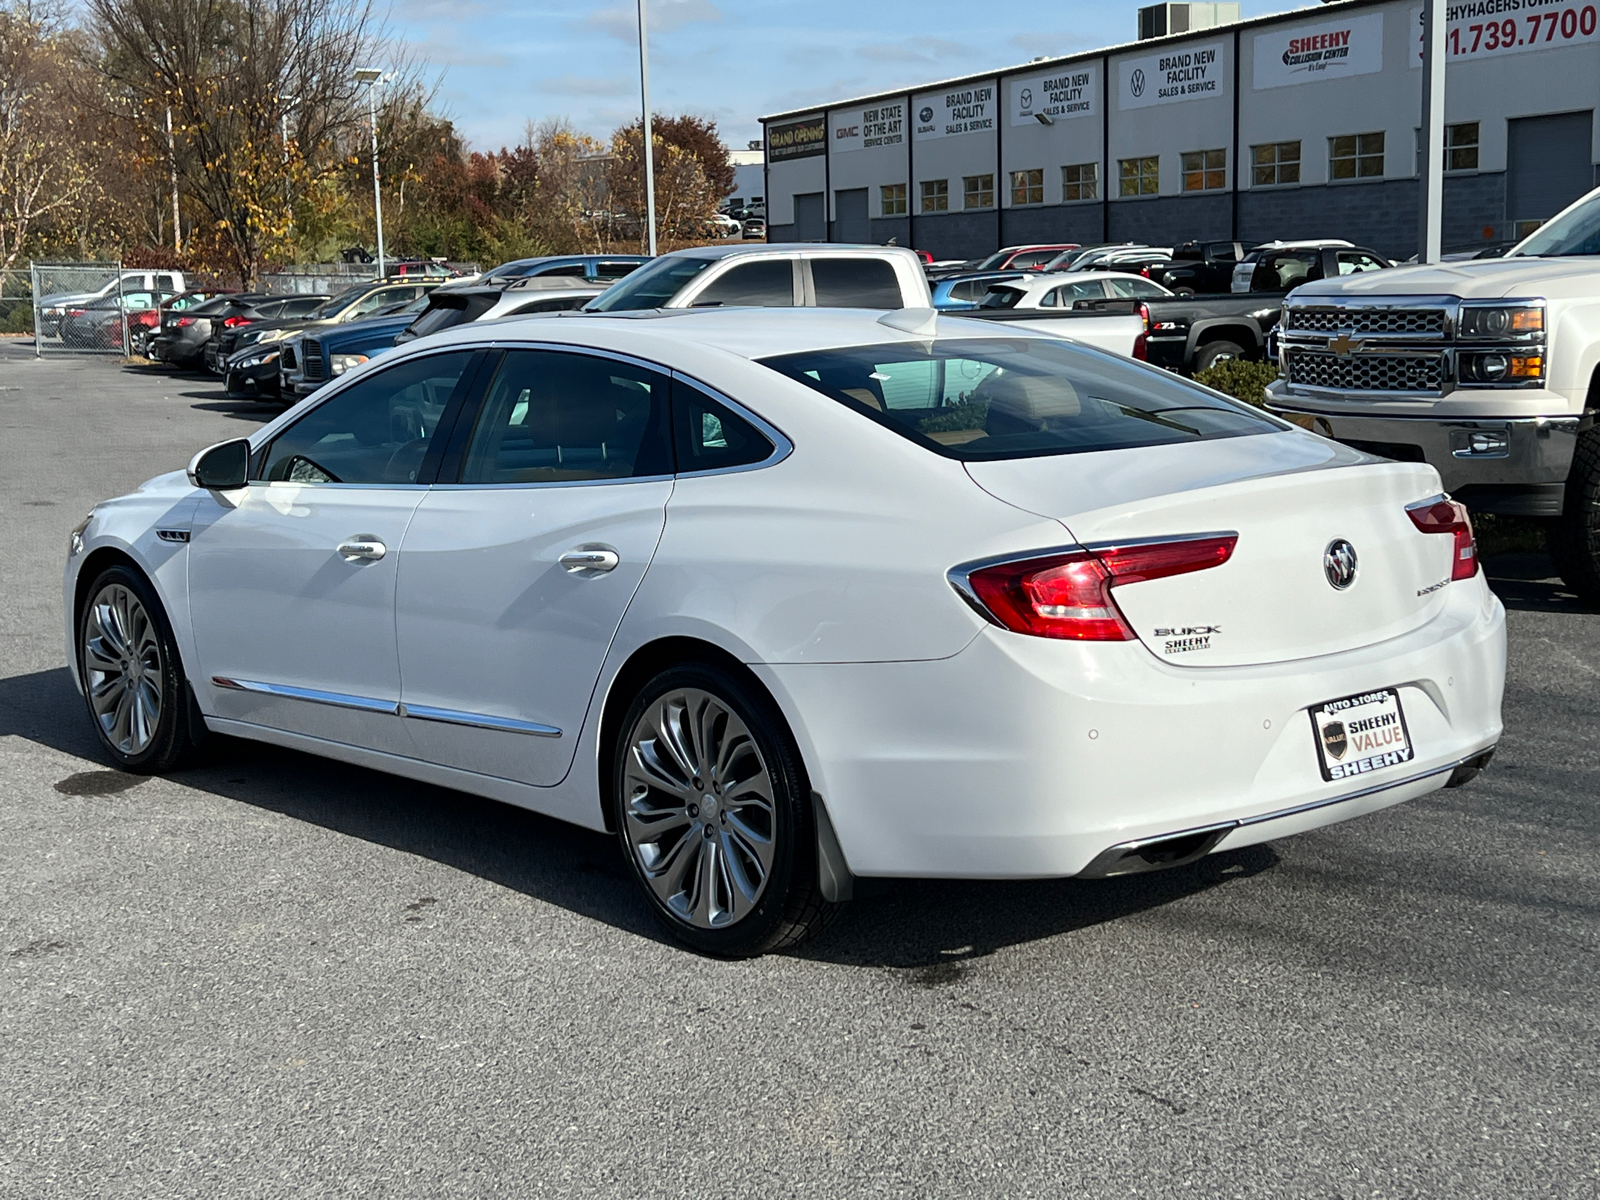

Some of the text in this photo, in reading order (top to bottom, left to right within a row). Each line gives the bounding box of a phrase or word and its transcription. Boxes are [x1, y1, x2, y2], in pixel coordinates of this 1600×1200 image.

[1289, 30, 1351, 54] SHEEHY
[1160, 49, 1215, 71] BRAND NEW
[1323, 47, 1349, 60] CENTER
[1043, 73, 1089, 92] BRAND NEW
[1167, 65, 1206, 84] FACILITY
[946, 88, 992, 108] BRAND NEW
[1050, 88, 1082, 104] FACILITY
[1158, 80, 1216, 98] SALES & SERVICE
[863, 105, 902, 123] NEW STATE
[952, 103, 985, 121] FACILITY
[1043, 106, 1060, 115] SALES
[1066, 101, 1090, 113] SERVICE
[836, 126, 859, 139] GMC
[863, 120, 902, 137] OF THE ART
[945, 118, 992, 134] SALES & SERVICE
[770, 125, 824, 147] GRAND OPENING
[1154, 625, 1222, 637] BUICK
[1165, 636, 1210, 649] SHEEHY
[1323, 690, 1390, 713] AUTO STORES
[1348, 712, 1397, 734] SHEEHY
[1351, 726, 1402, 752] VALUE
[1329, 748, 1410, 780] SHEEHY
